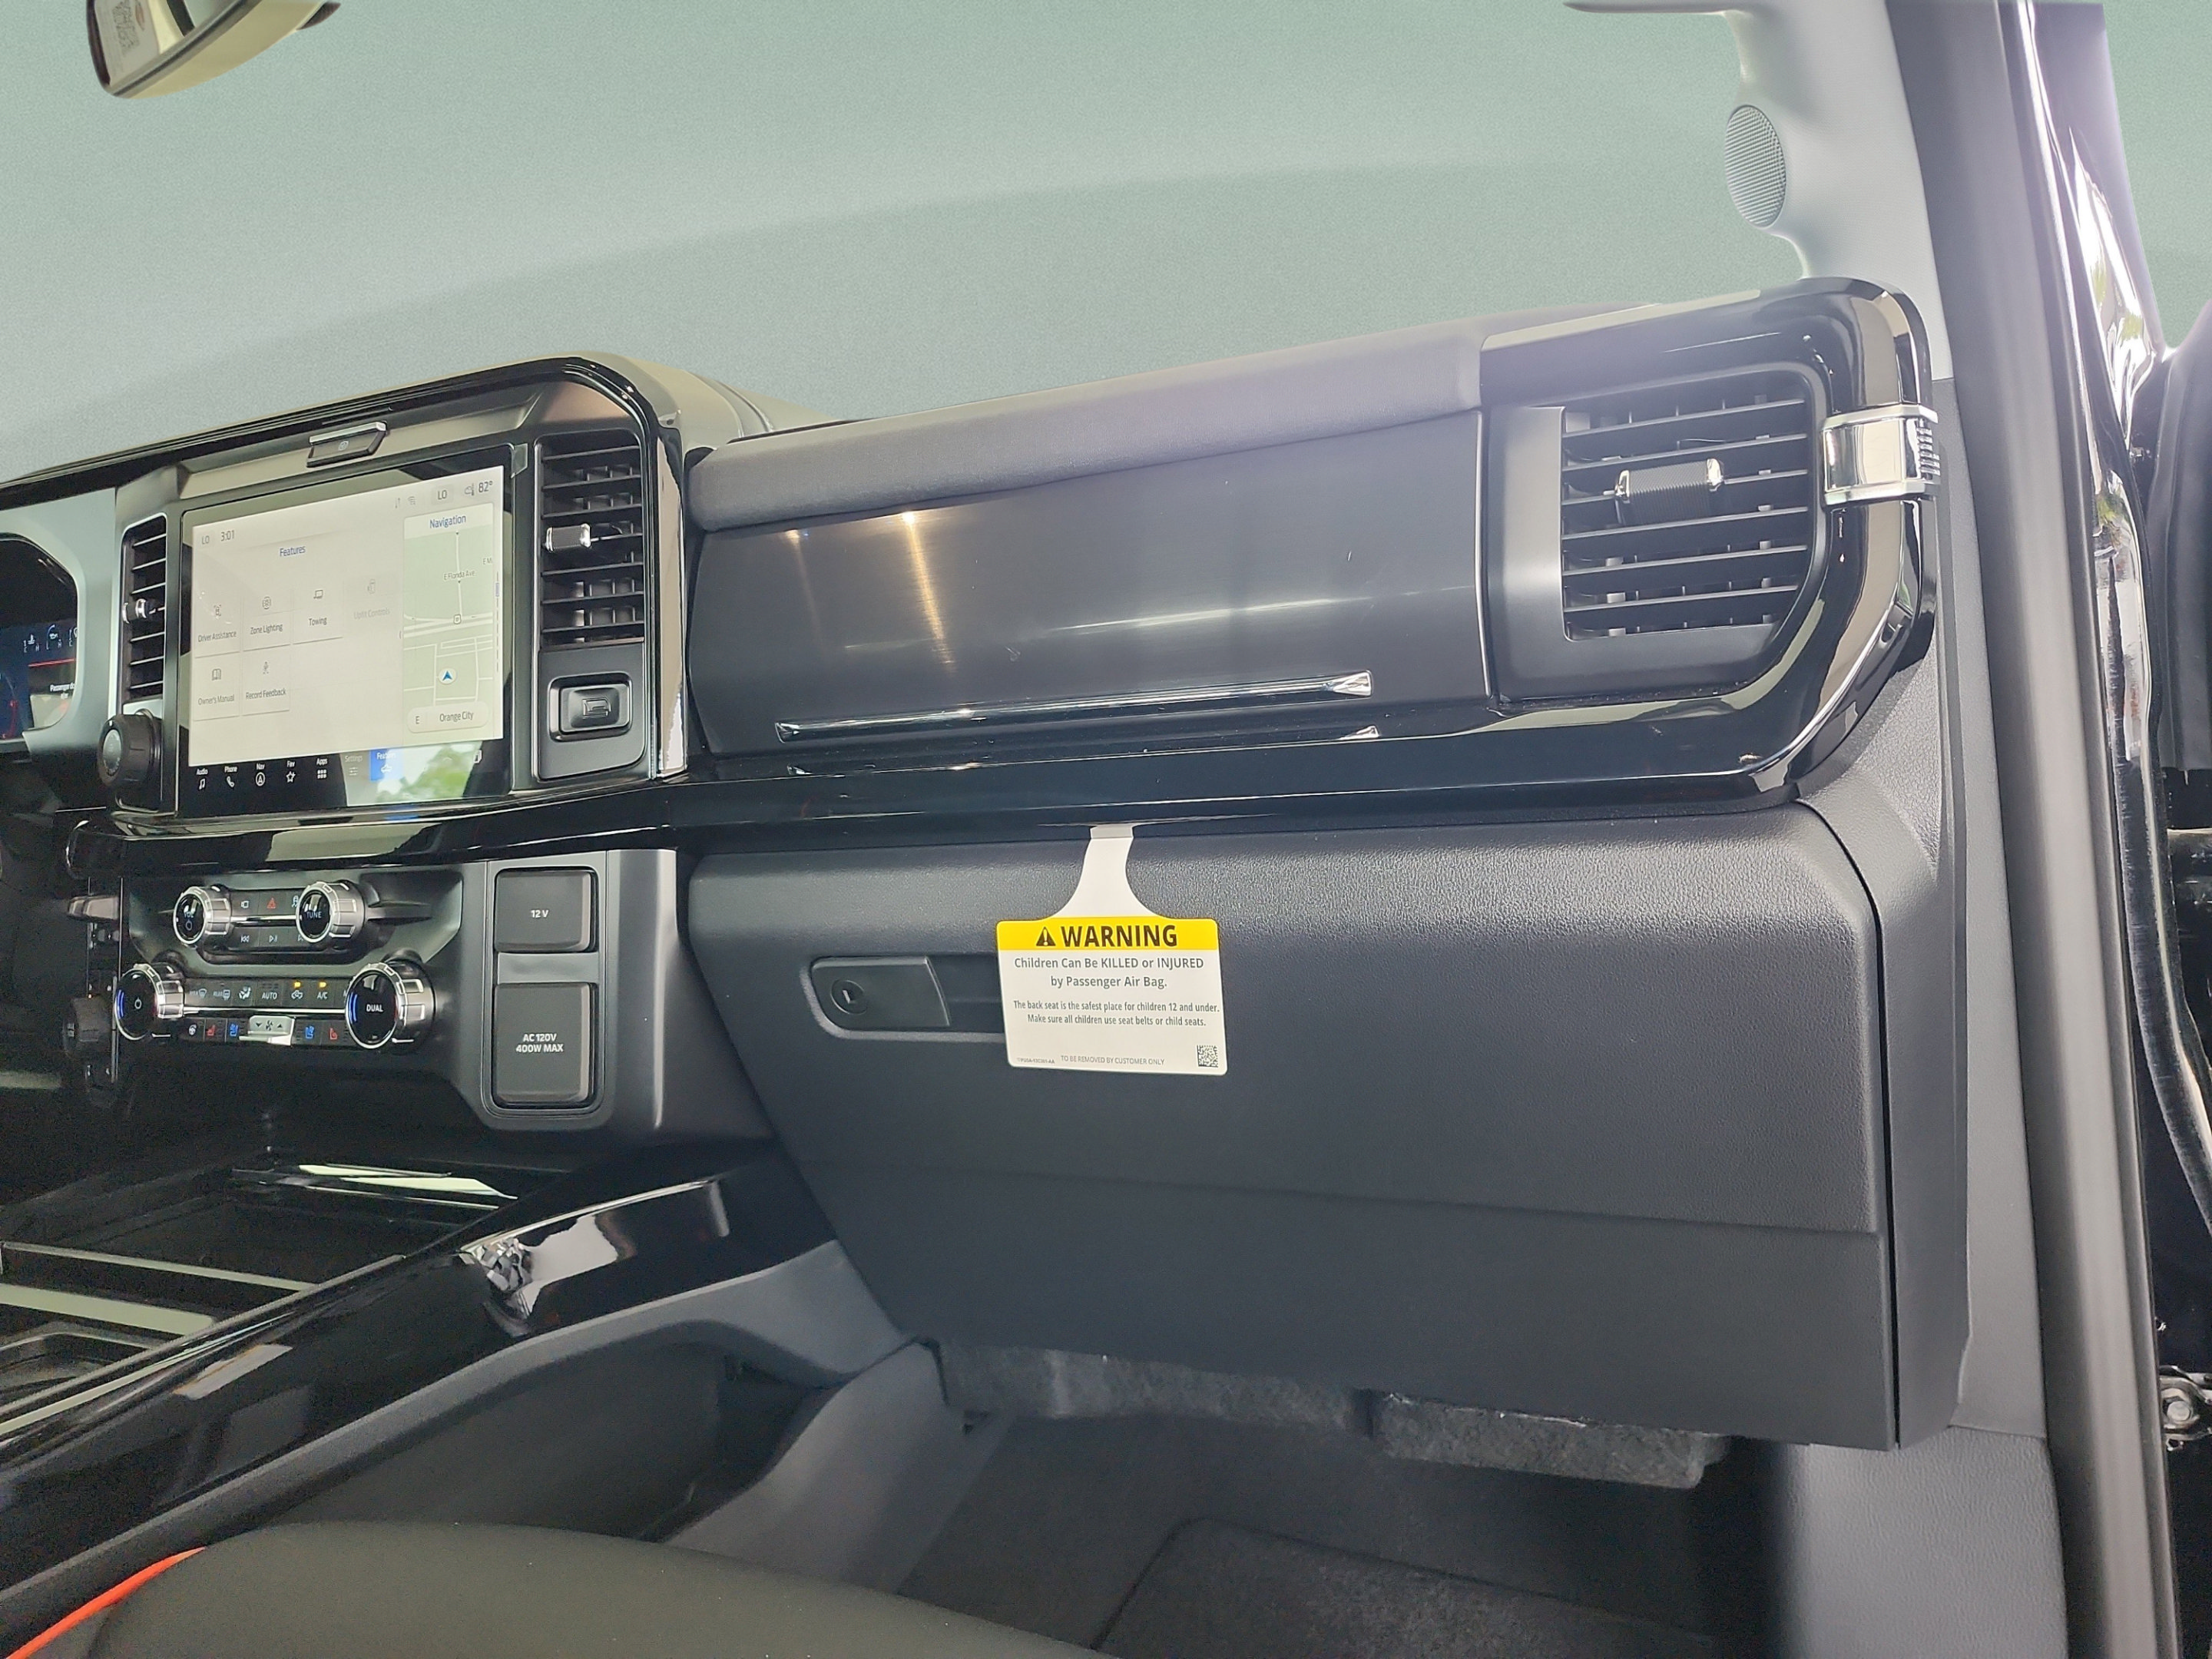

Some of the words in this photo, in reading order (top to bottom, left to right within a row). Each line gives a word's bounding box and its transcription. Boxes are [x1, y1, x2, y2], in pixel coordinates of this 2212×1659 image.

[478, 481, 492, 493] 82°
[438, 490, 447, 499] LO
[429, 515, 466, 528] Navigation
[201, 535, 210, 545] LO
[220, 530, 235, 541] 3:01
[280, 545, 306, 557] Features
[309, 617, 327, 626] Towing
[263, 623, 283, 634] Lighting
[198, 633, 212, 642] Driver
[212, 630, 237, 640] Assistance
[198, 696, 217, 705] Owner's
[217, 694, 235, 704] Manual
[246, 690, 263, 700] Record
[263, 688, 286, 697] Feedback
[416, 716, 419, 724] E
[439, 713, 461, 724] Orange
[462, 711, 474, 720] City
[316, 757, 327, 766] Apps
[530, 909, 541, 919] 12
[542, 909, 549, 919] V
[1061, 925, 1177, 947] WARNING
[1015, 957, 1058, 968] Children
[1061, 958, 1081, 968] Can
[1084, 958, 1098, 968] Be
[1101, 958, 1138, 968] KILLED
[1141, 959, 1154, 968] or
[1157, 958, 1204, 970] INJURED
[1051, 975, 1063, 989] by
[1066, 977, 1121, 989] Passenger
[1124, 976, 1141, 987] Air
[1144, 977, 1167, 989] Bag.
[1014, 1000, 1026, 1009] The
[1028, 1000, 1043, 1009] back
[1045, 1002, 1059, 1010] seat
[1061, 1001, 1066, 1010] is
[1068, 1002, 1080, 1010] the
[1081, 1002, 1101, 1011] safest
[1104, 1002, 1123, 1012] place
[1124, 1002, 1135, 1011] for
[1137, 1002, 1166, 1012] children
[1168, 1003, 1177, 1012] 12
[1180, 1003, 1194, 1012] and
[1195, 1003, 1220, 1012] under.
[1028, 1014, 1046, 1023] Make
[1075, 1015, 1103, 1025] children
[1135, 1015, 1154, 1025] belts
[1165, 1017, 1183, 1026] child
[1184, 1018, 1206, 1026] seats.
[522, 1034, 535, 1042] AC
[535, 1034, 558, 1042] 120V
[543, 1044, 564, 1052] MAX
